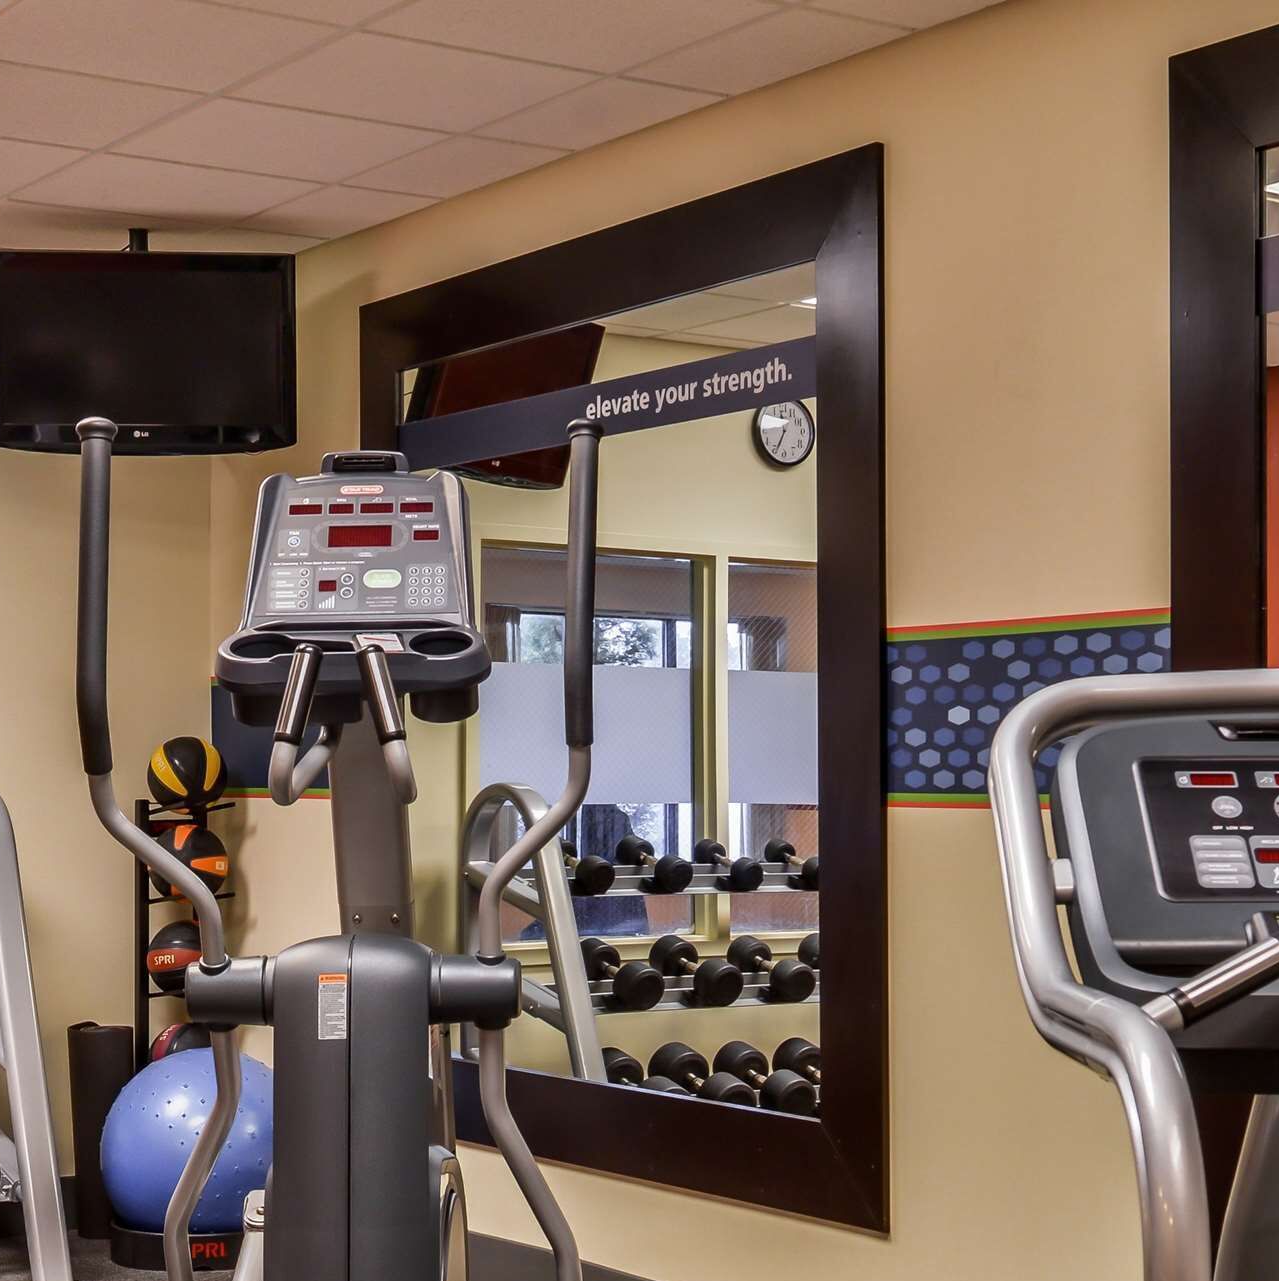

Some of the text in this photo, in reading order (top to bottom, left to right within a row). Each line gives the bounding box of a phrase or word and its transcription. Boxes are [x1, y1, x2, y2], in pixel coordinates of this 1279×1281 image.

[586, 358, 793, 420] elevate your strength.
[154, 955, 175, 966] SPRI
[192, 1241, 228, 1259] PRI
